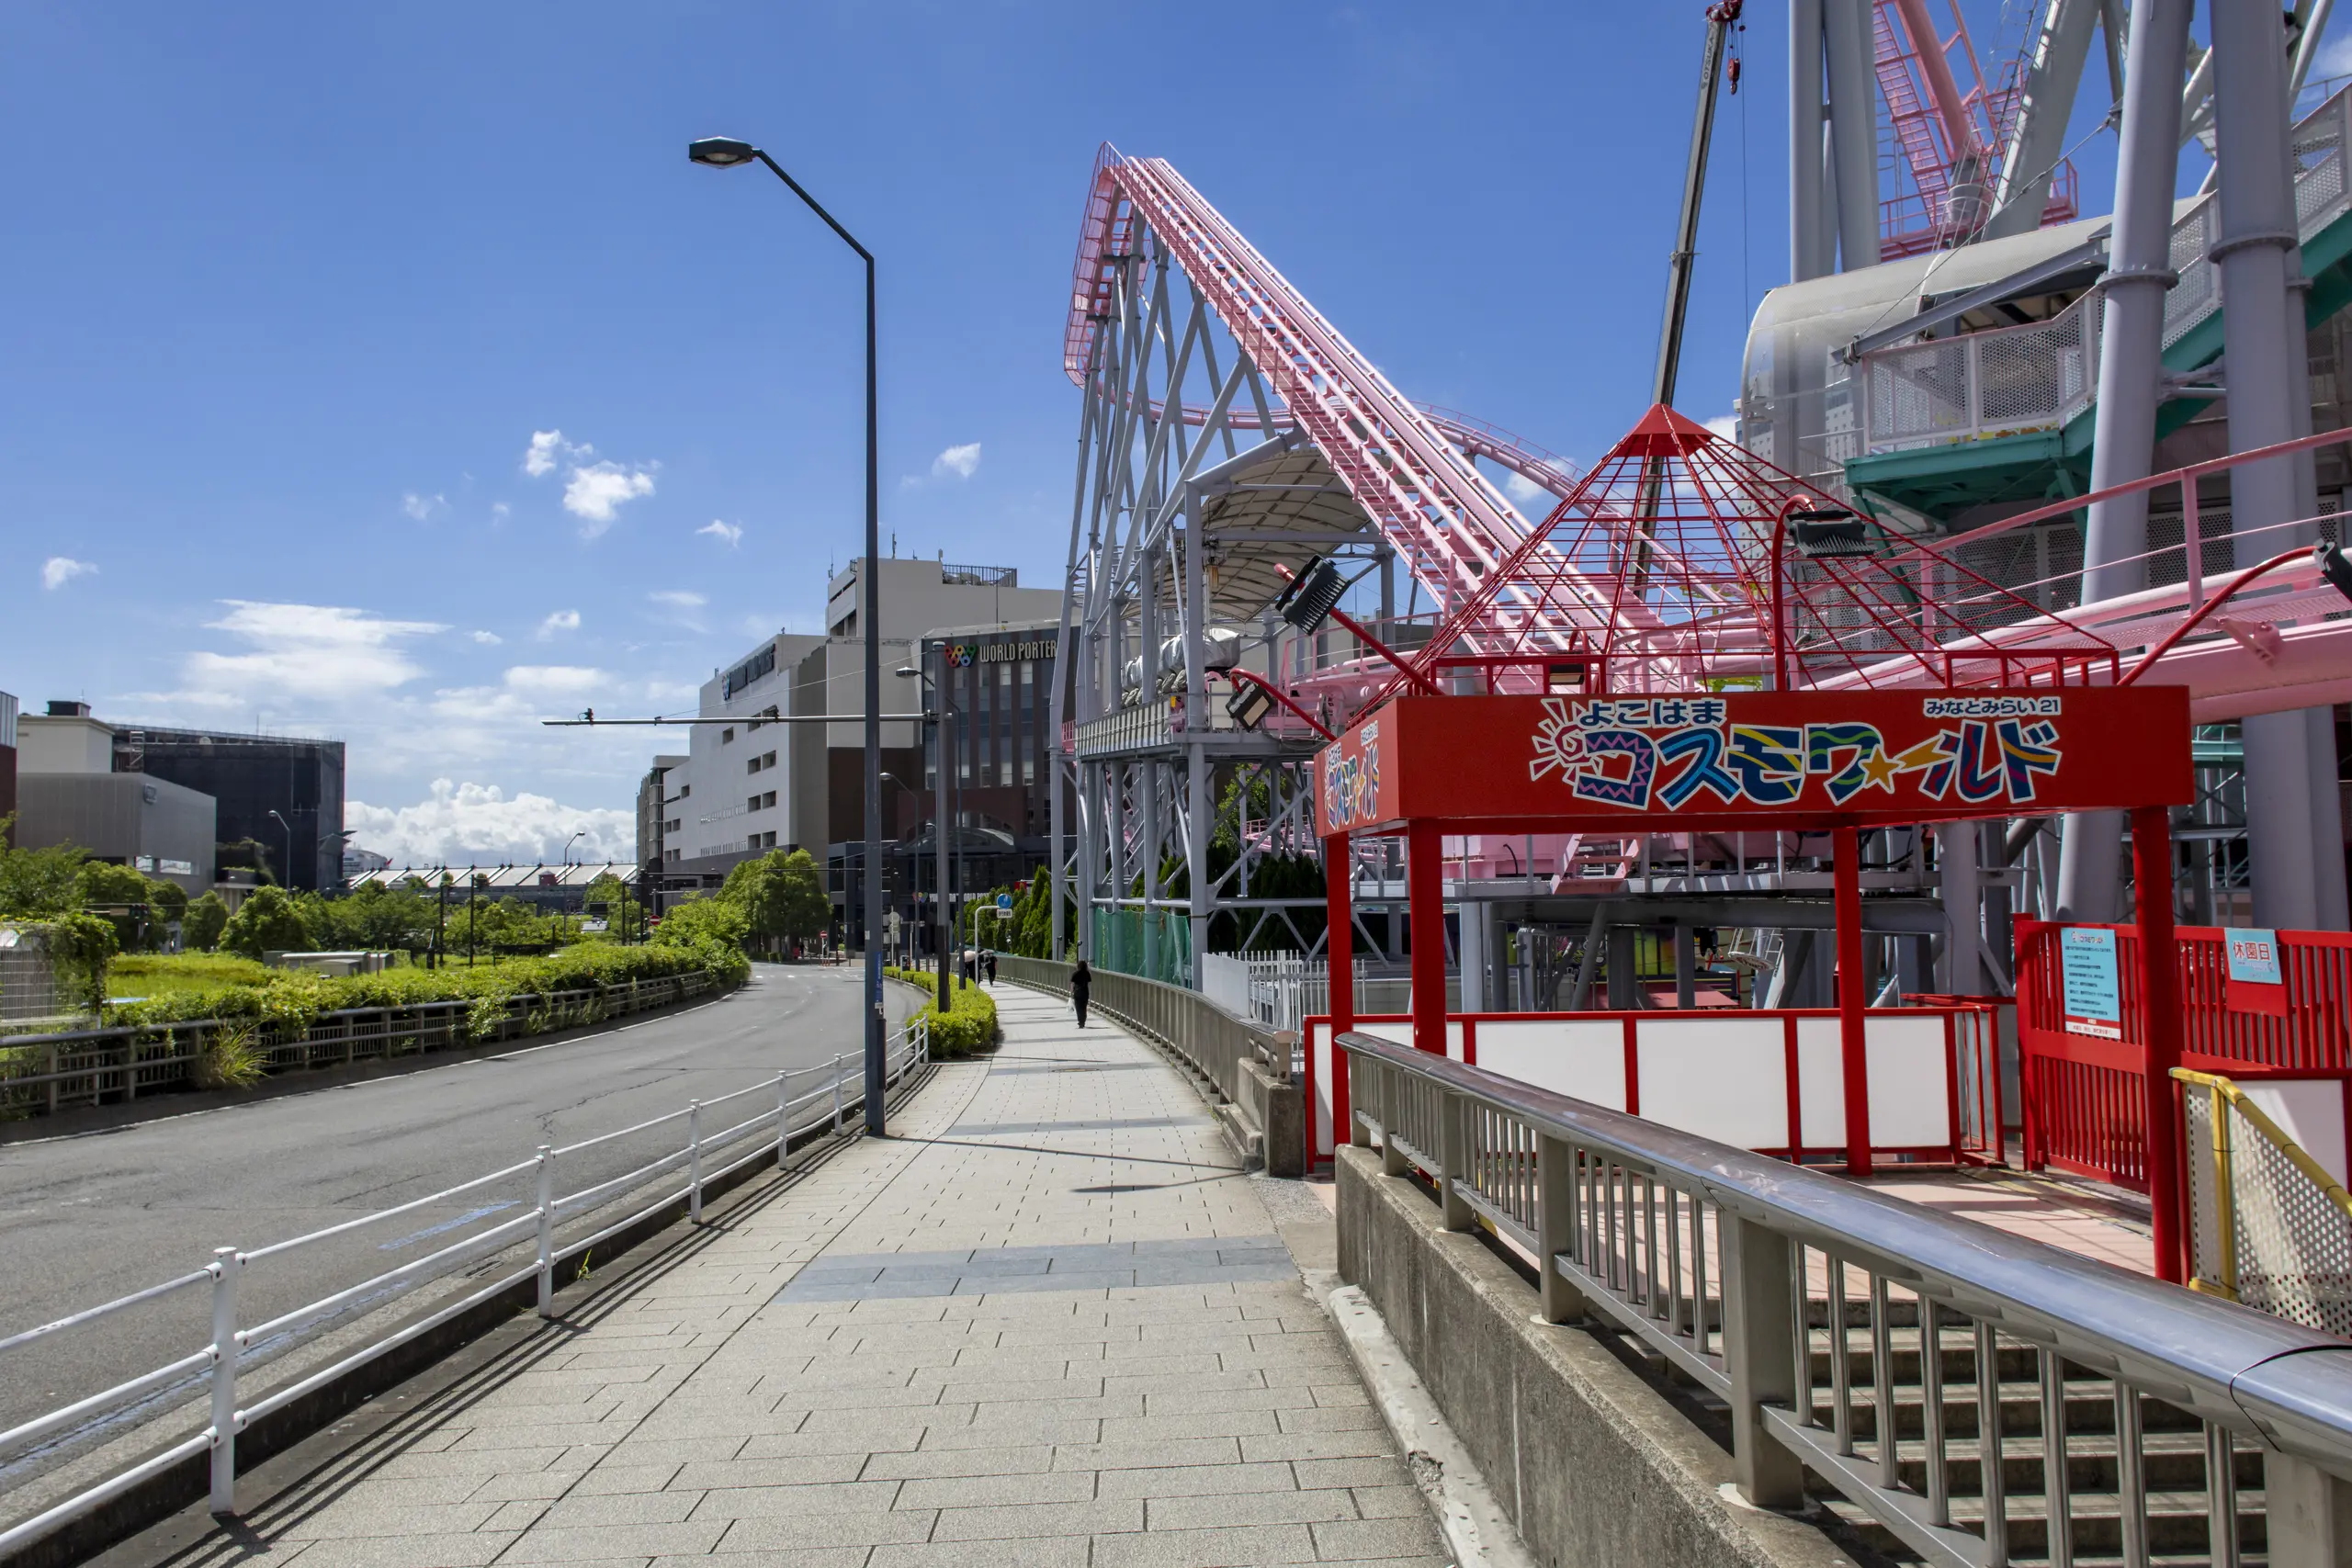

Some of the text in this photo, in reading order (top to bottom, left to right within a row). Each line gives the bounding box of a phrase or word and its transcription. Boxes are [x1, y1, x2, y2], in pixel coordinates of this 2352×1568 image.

[979, 643, 1015, 662] WORLD
[1578, 699, 1725, 728] よこはま
[1925, 698, 2060, 716] みなとみらい21
[2233, 940, 2271, 961] 休園日
